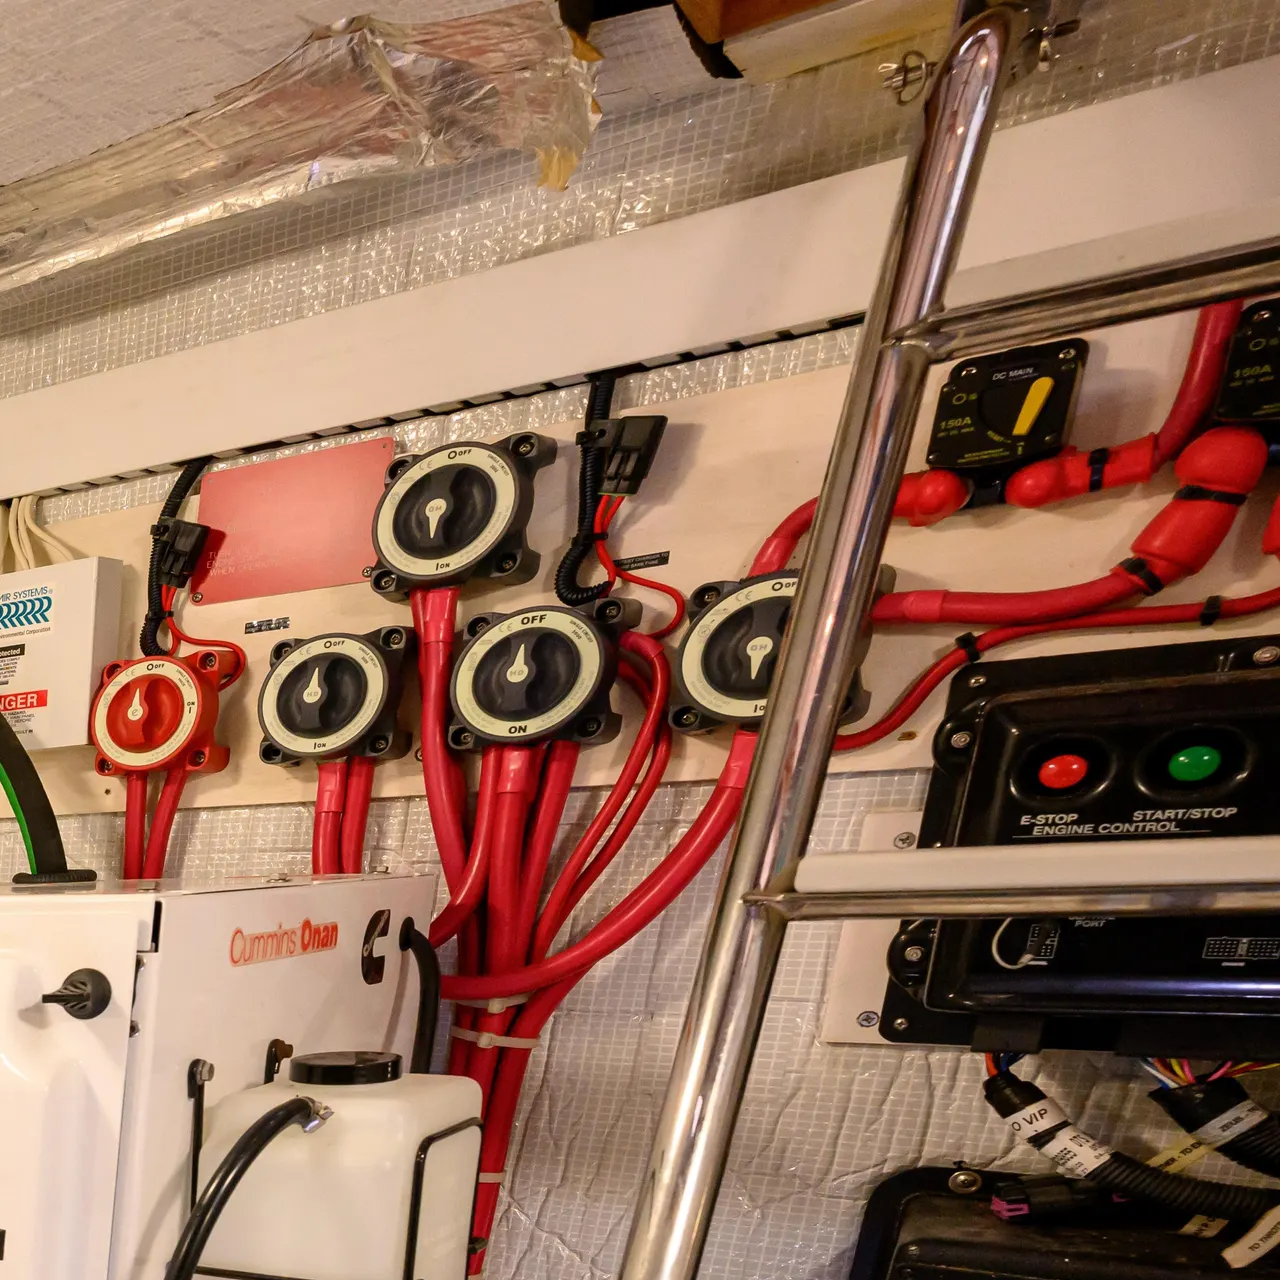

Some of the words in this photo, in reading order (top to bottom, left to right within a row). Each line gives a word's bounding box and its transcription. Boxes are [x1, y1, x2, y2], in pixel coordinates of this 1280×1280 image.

[458, 449, 472, 457] OFF
[13, 586, 48, 600] SYSTEMS
[520, 614, 547, 625] OFF
[25, 627, 51, 635] Corporation
[508, 725, 528, 734] ON
[1020, 814, 1079, 826] E-STOP
[1132, 807, 1238, 822] START/STOP
[1032, 823, 1094, 836] ENGINE
[1098, 821, 1180, 833] CONTROL
[1075, 919, 1106, 928] PORT
[230, 924, 296, 965] Cummins
[300, 918, 338, 952] Onan
[1022, 1108, 1048, 1125] VIP
